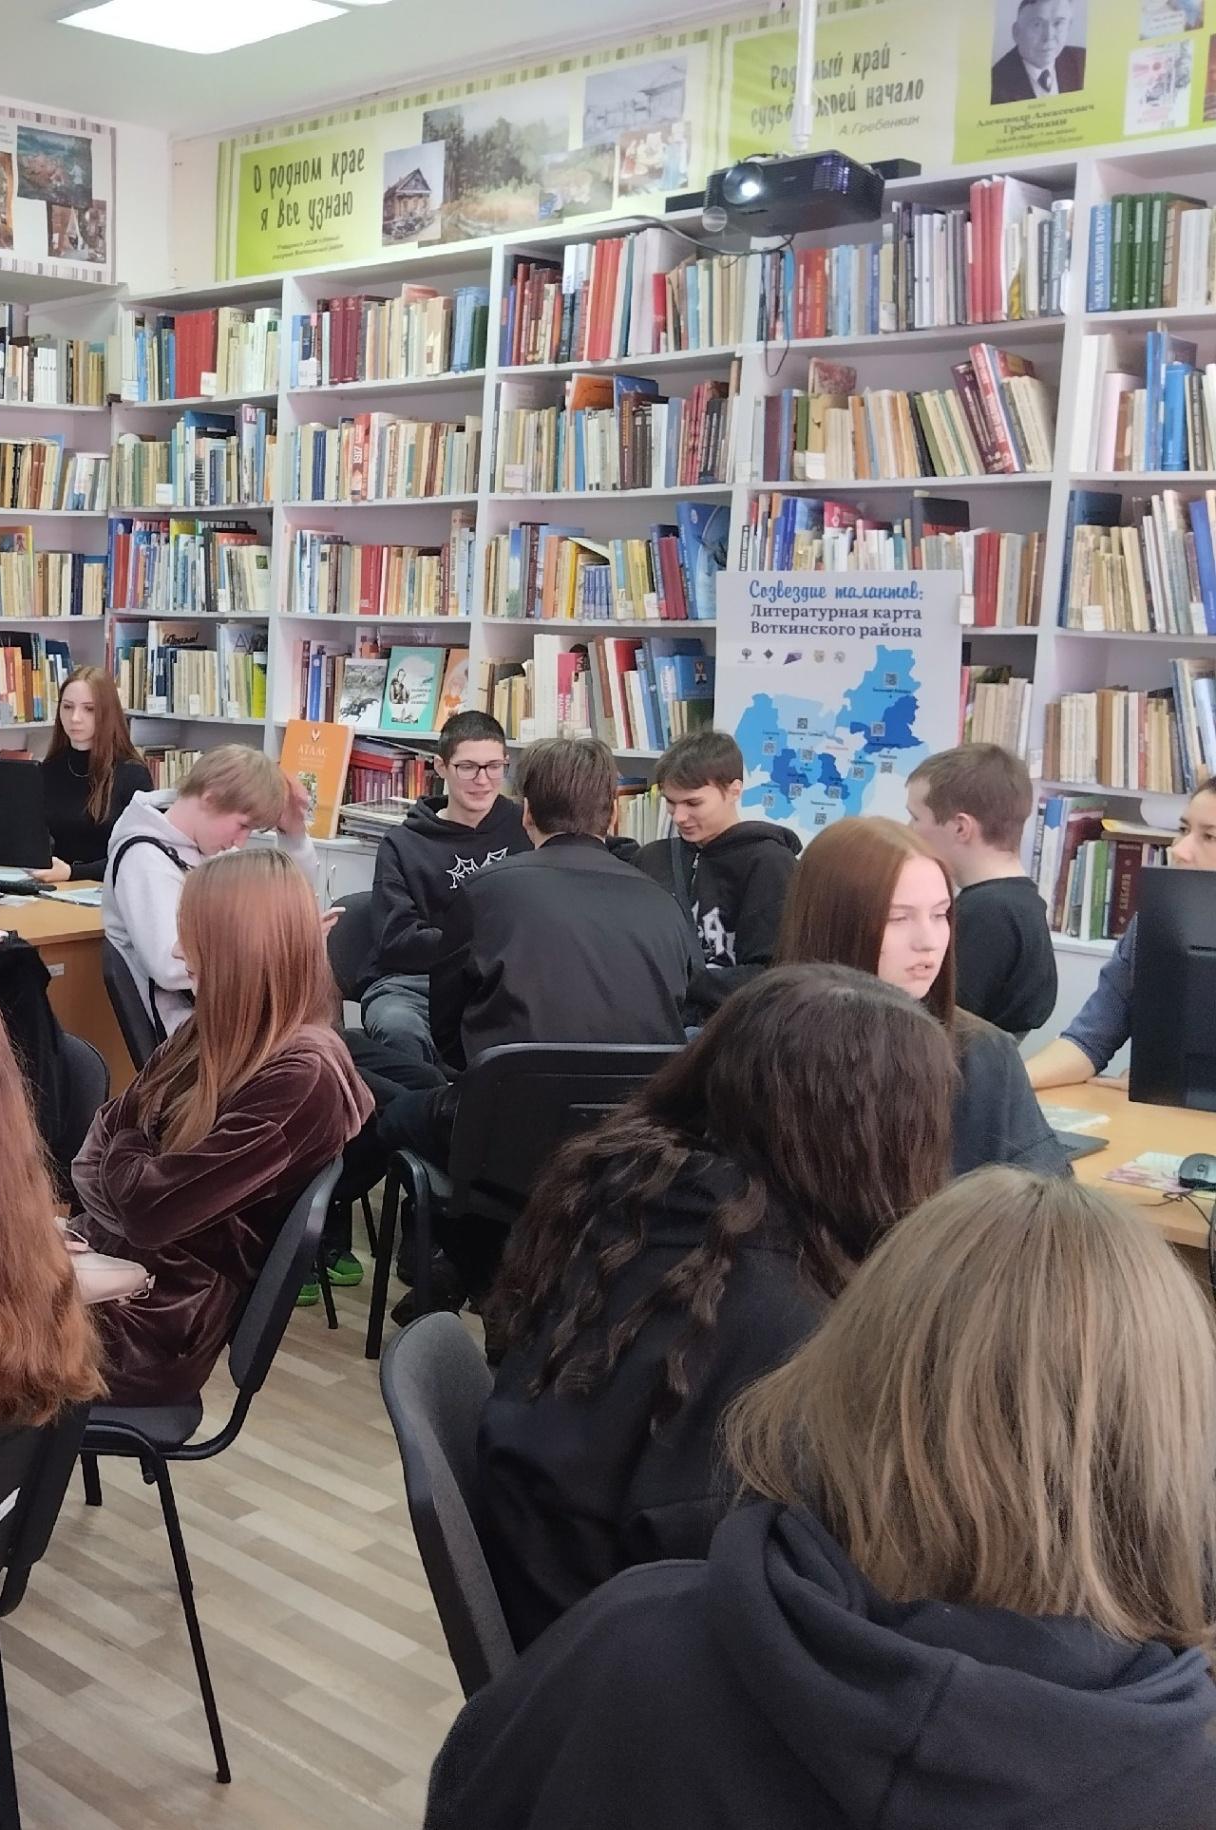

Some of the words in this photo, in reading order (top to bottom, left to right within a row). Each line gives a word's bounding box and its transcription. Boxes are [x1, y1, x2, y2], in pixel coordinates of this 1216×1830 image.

[851, 42, 891, 80] край
[751, 97, 794, 135] судьб
[815, 84, 857, 118] моей
[866, 78, 925, 109] начало
[253, 164, 262, 193] О
[269, 156, 322, 200] родном
[331, 147, 365, 185] крае
[260, 207, 269, 231] я
[277, 197, 301, 229] все
[308, 191, 354, 232] узнаю
[749, 579, 827, 603] Созвездие
[834, 579, 924, 601] талантов:
[750, 604, 869, 621] Литературная
[873, 606, 923, 622] карта
[750, 620, 856, 636] Воткинского
[859, 623, 923, 640] района
